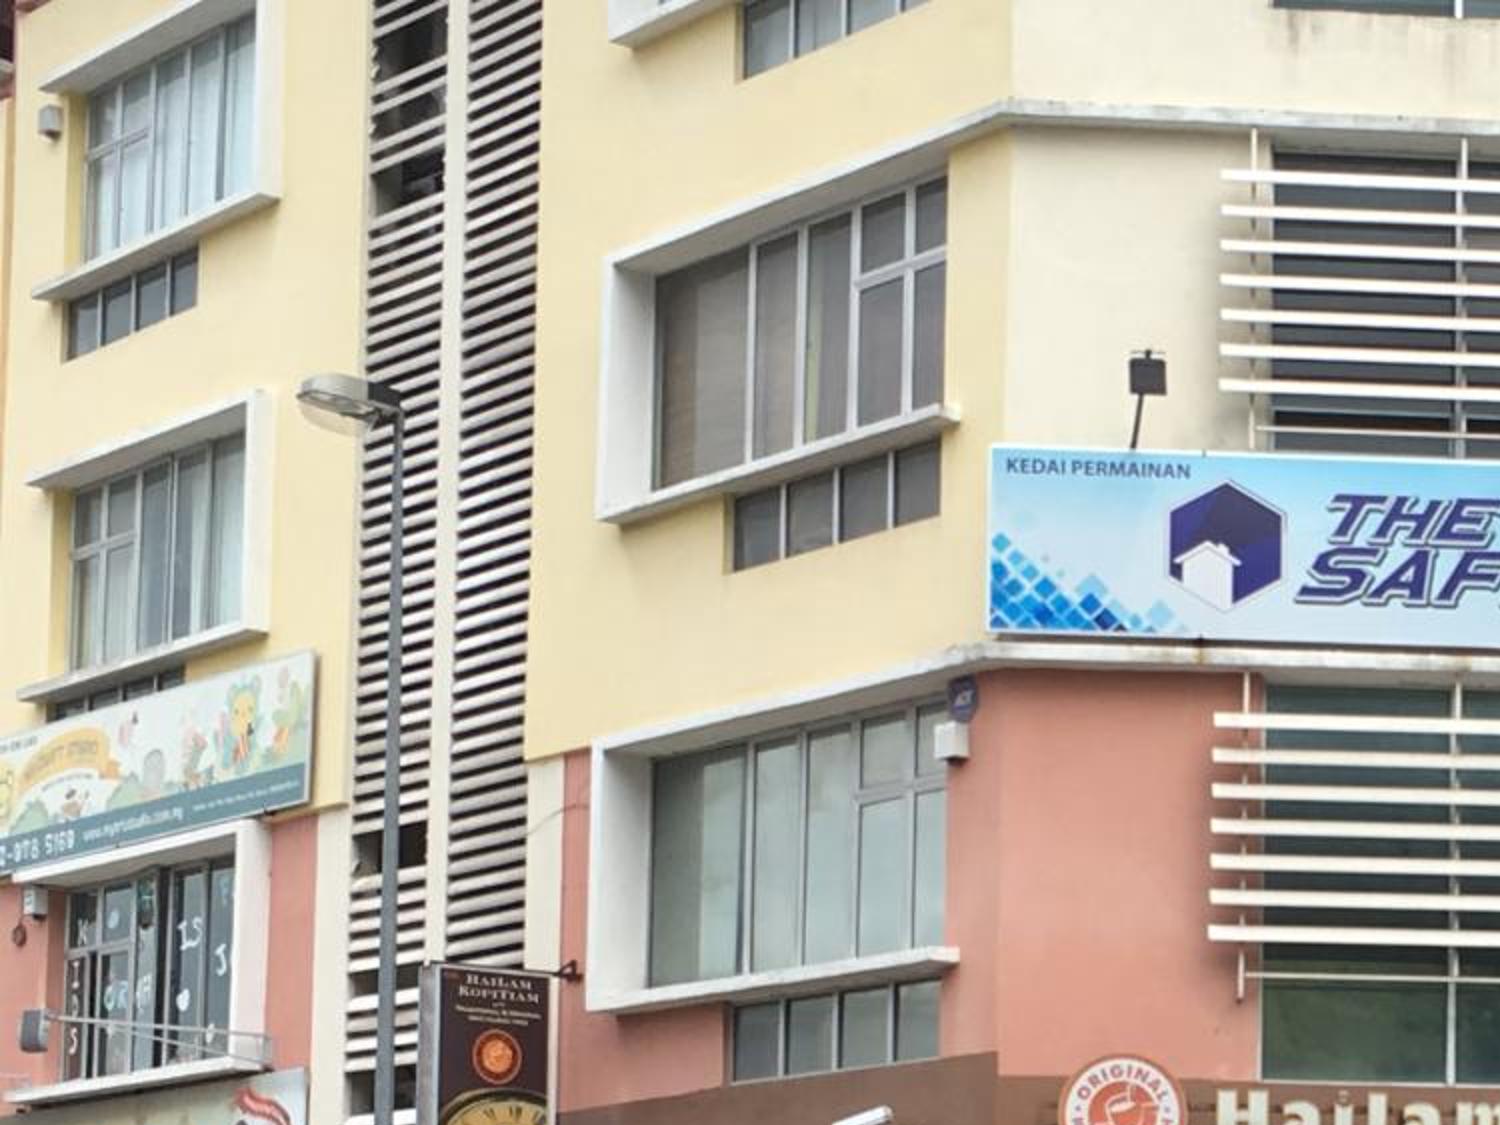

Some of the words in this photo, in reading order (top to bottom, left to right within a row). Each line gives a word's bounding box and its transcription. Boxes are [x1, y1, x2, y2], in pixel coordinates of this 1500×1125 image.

[1006, 458, 1068, 477] KEDAI
[1072, 460, 1192, 481] PERMAINAN
[1077, 1064, 1168, 1100] ORIGINAL
